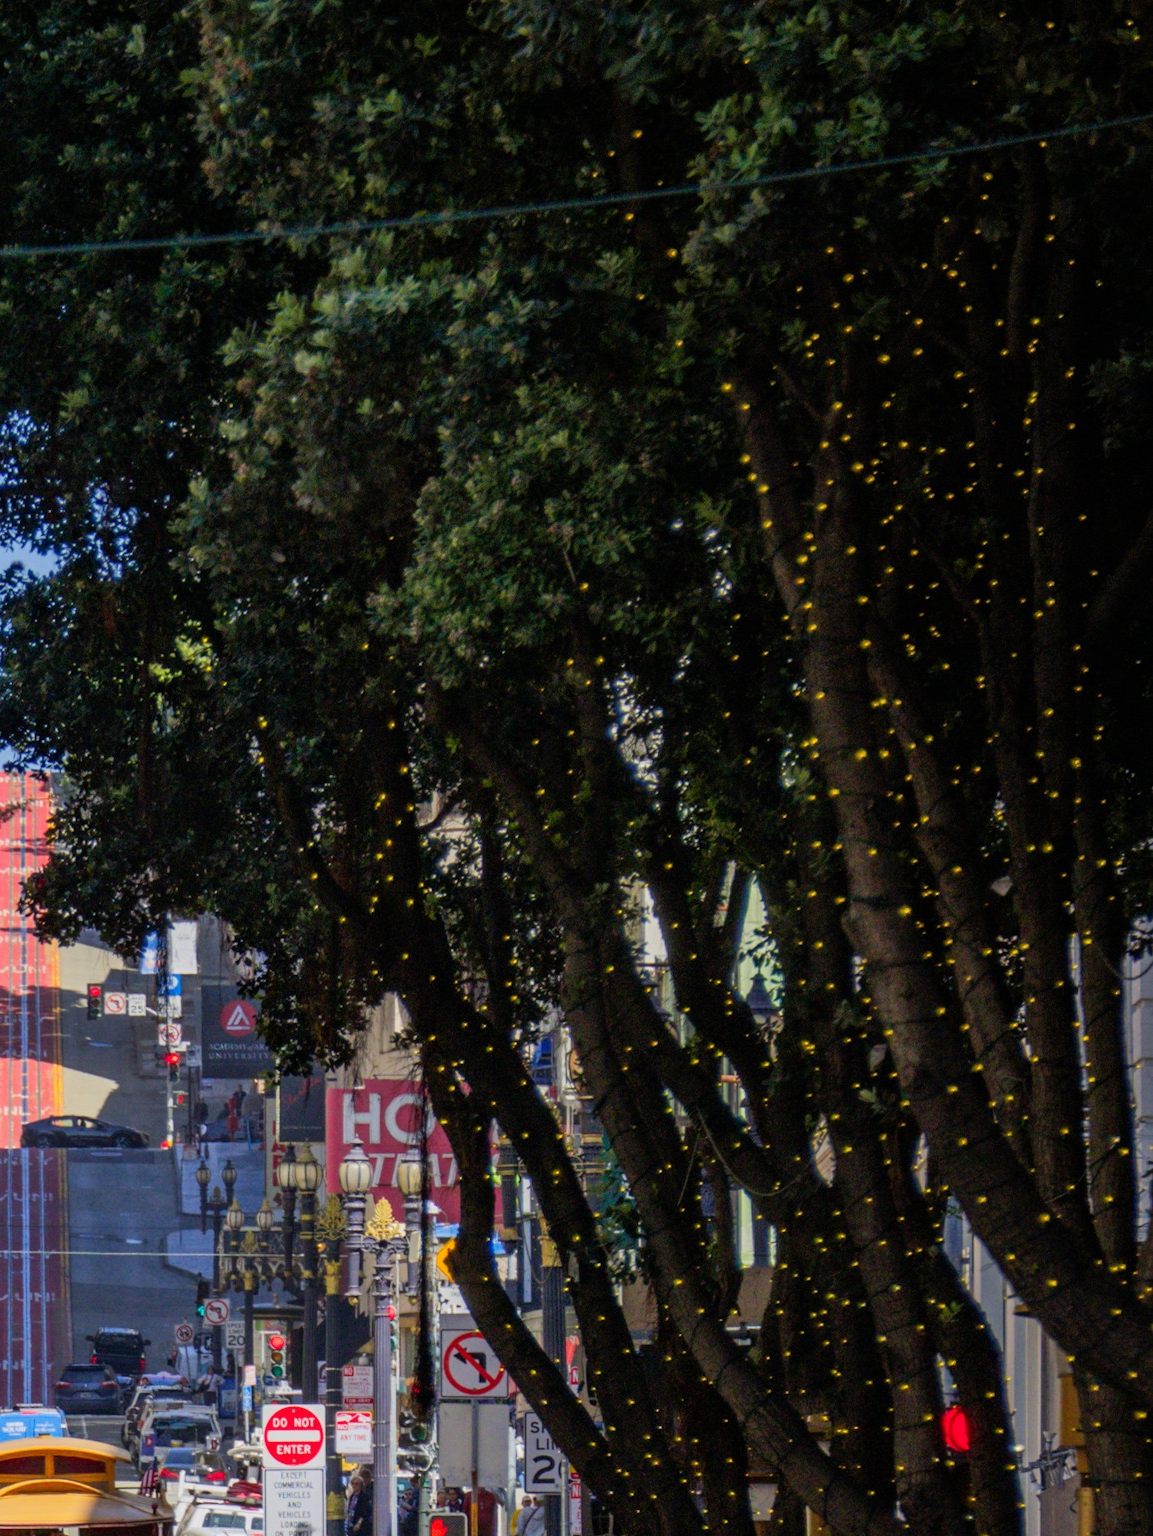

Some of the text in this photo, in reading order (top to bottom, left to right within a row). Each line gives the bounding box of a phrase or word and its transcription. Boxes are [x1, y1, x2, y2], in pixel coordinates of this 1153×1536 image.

[228, 1335, 245, 1346] 20
[344, 1368, 352, 1376] NO
[272, 1417, 315, 1428] DO NOT
[276, 1444, 311, 1455] ENTER
